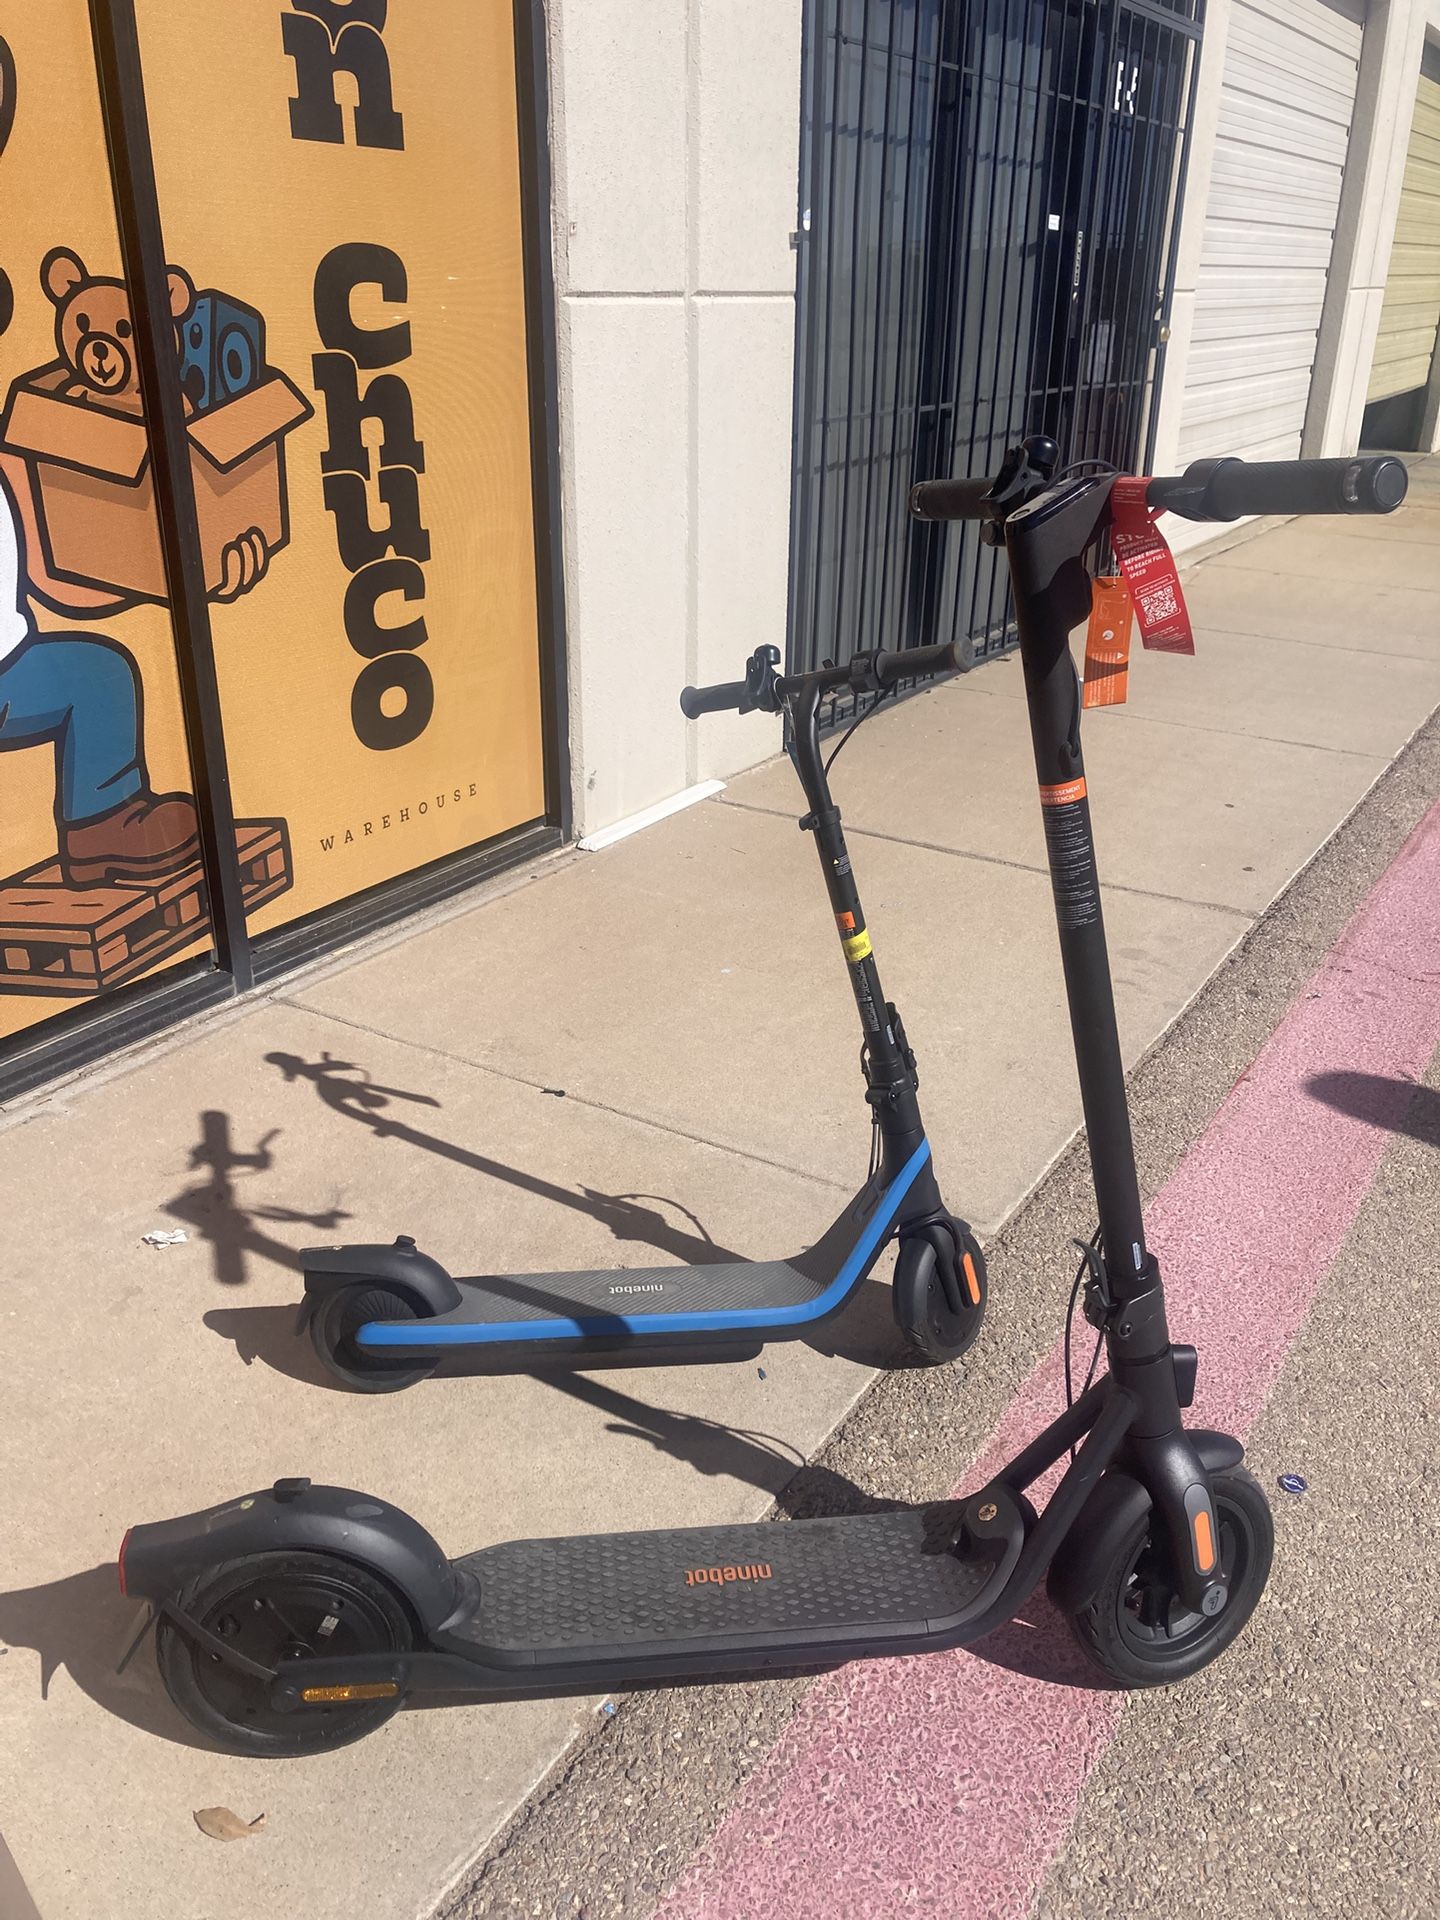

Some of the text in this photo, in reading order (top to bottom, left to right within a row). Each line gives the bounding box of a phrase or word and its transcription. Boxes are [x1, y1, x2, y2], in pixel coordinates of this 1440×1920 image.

[1124, 553, 1145, 566] BEFORE
[1134, 559, 1153, 571] REACH
[1152, 553, 1166, 563] FULL
[1129, 568, 1147, 580] SPEED
[320, 783, 477, 852] WAREHOUSE
[608, 1284, 664, 1294] ninebot
[684, 1564, 772, 1587] ninebot
